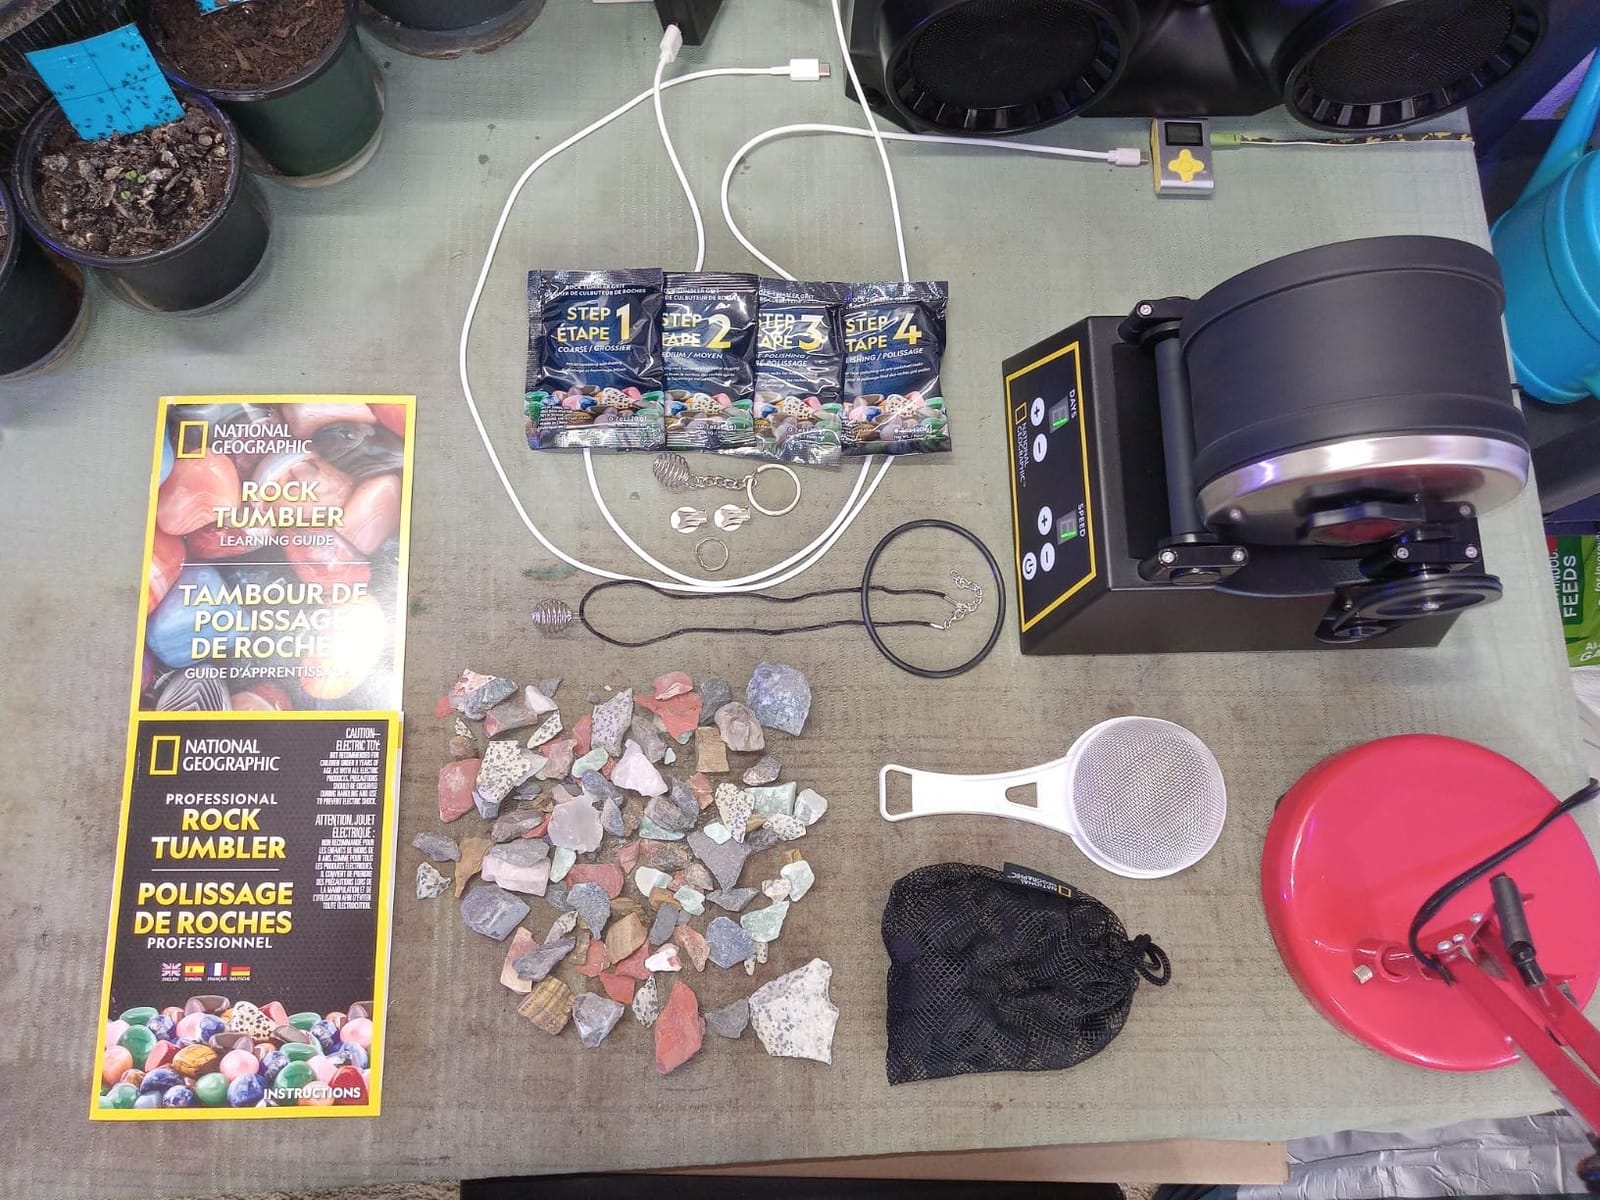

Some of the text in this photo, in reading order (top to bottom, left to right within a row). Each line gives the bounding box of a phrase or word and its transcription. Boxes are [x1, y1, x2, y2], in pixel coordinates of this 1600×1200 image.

[567, 303, 631, 341] STEP 1
[707, 313, 731, 349] 2
[759, 313, 824, 350] TEP 3
[846, 312, 922, 345] STEP 4
[557, 323, 610, 342] ÉTAPE
[557, 345, 588, 353] COARSE
[593, 344, 632, 352] GROSSIER
[845, 335, 888, 352] TAPE
[846, 354, 876, 363] LISHING
[882, 347, 925, 359] POLISSAGE
[1068, 388, 1078, 419] DAYS
[213, 424, 292, 438] NATIONAL
[211, 440, 313, 454] GEOGRAPHIC
[241, 480, 320, 502] ROCK
[212, 506, 345, 528] TUMBLER
[1077, 503, 1086, 537] SPEED
[220, 535, 334, 547] LEARNING GUIDE
[178, 583, 324, 607] TAMBOUR
[1562, 554, 1579, 618] FEEDS
[191, 637, 228, 660] DE
[184, 667, 227, 679] GUIDE
[184, 739, 261, 754] NATIONAL
[336, 740, 366, 751] ELECTRIC
[182, 756, 281, 772] GEOGRAPHIC
[165, 793, 278, 805] PROFESSIONAL
[181, 808, 262, 831] ROCK
[354, 814, 376, 826] JOUET
[151, 836, 287, 859] TUMBLER
[137, 882, 294, 906] POLISSAGE
[133, 911, 293, 935] DE ROCHES
[147, 937, 273, 949] PROFESSIONNEL
[263, 1087, 361, 1099] INSTRUCTIONS
